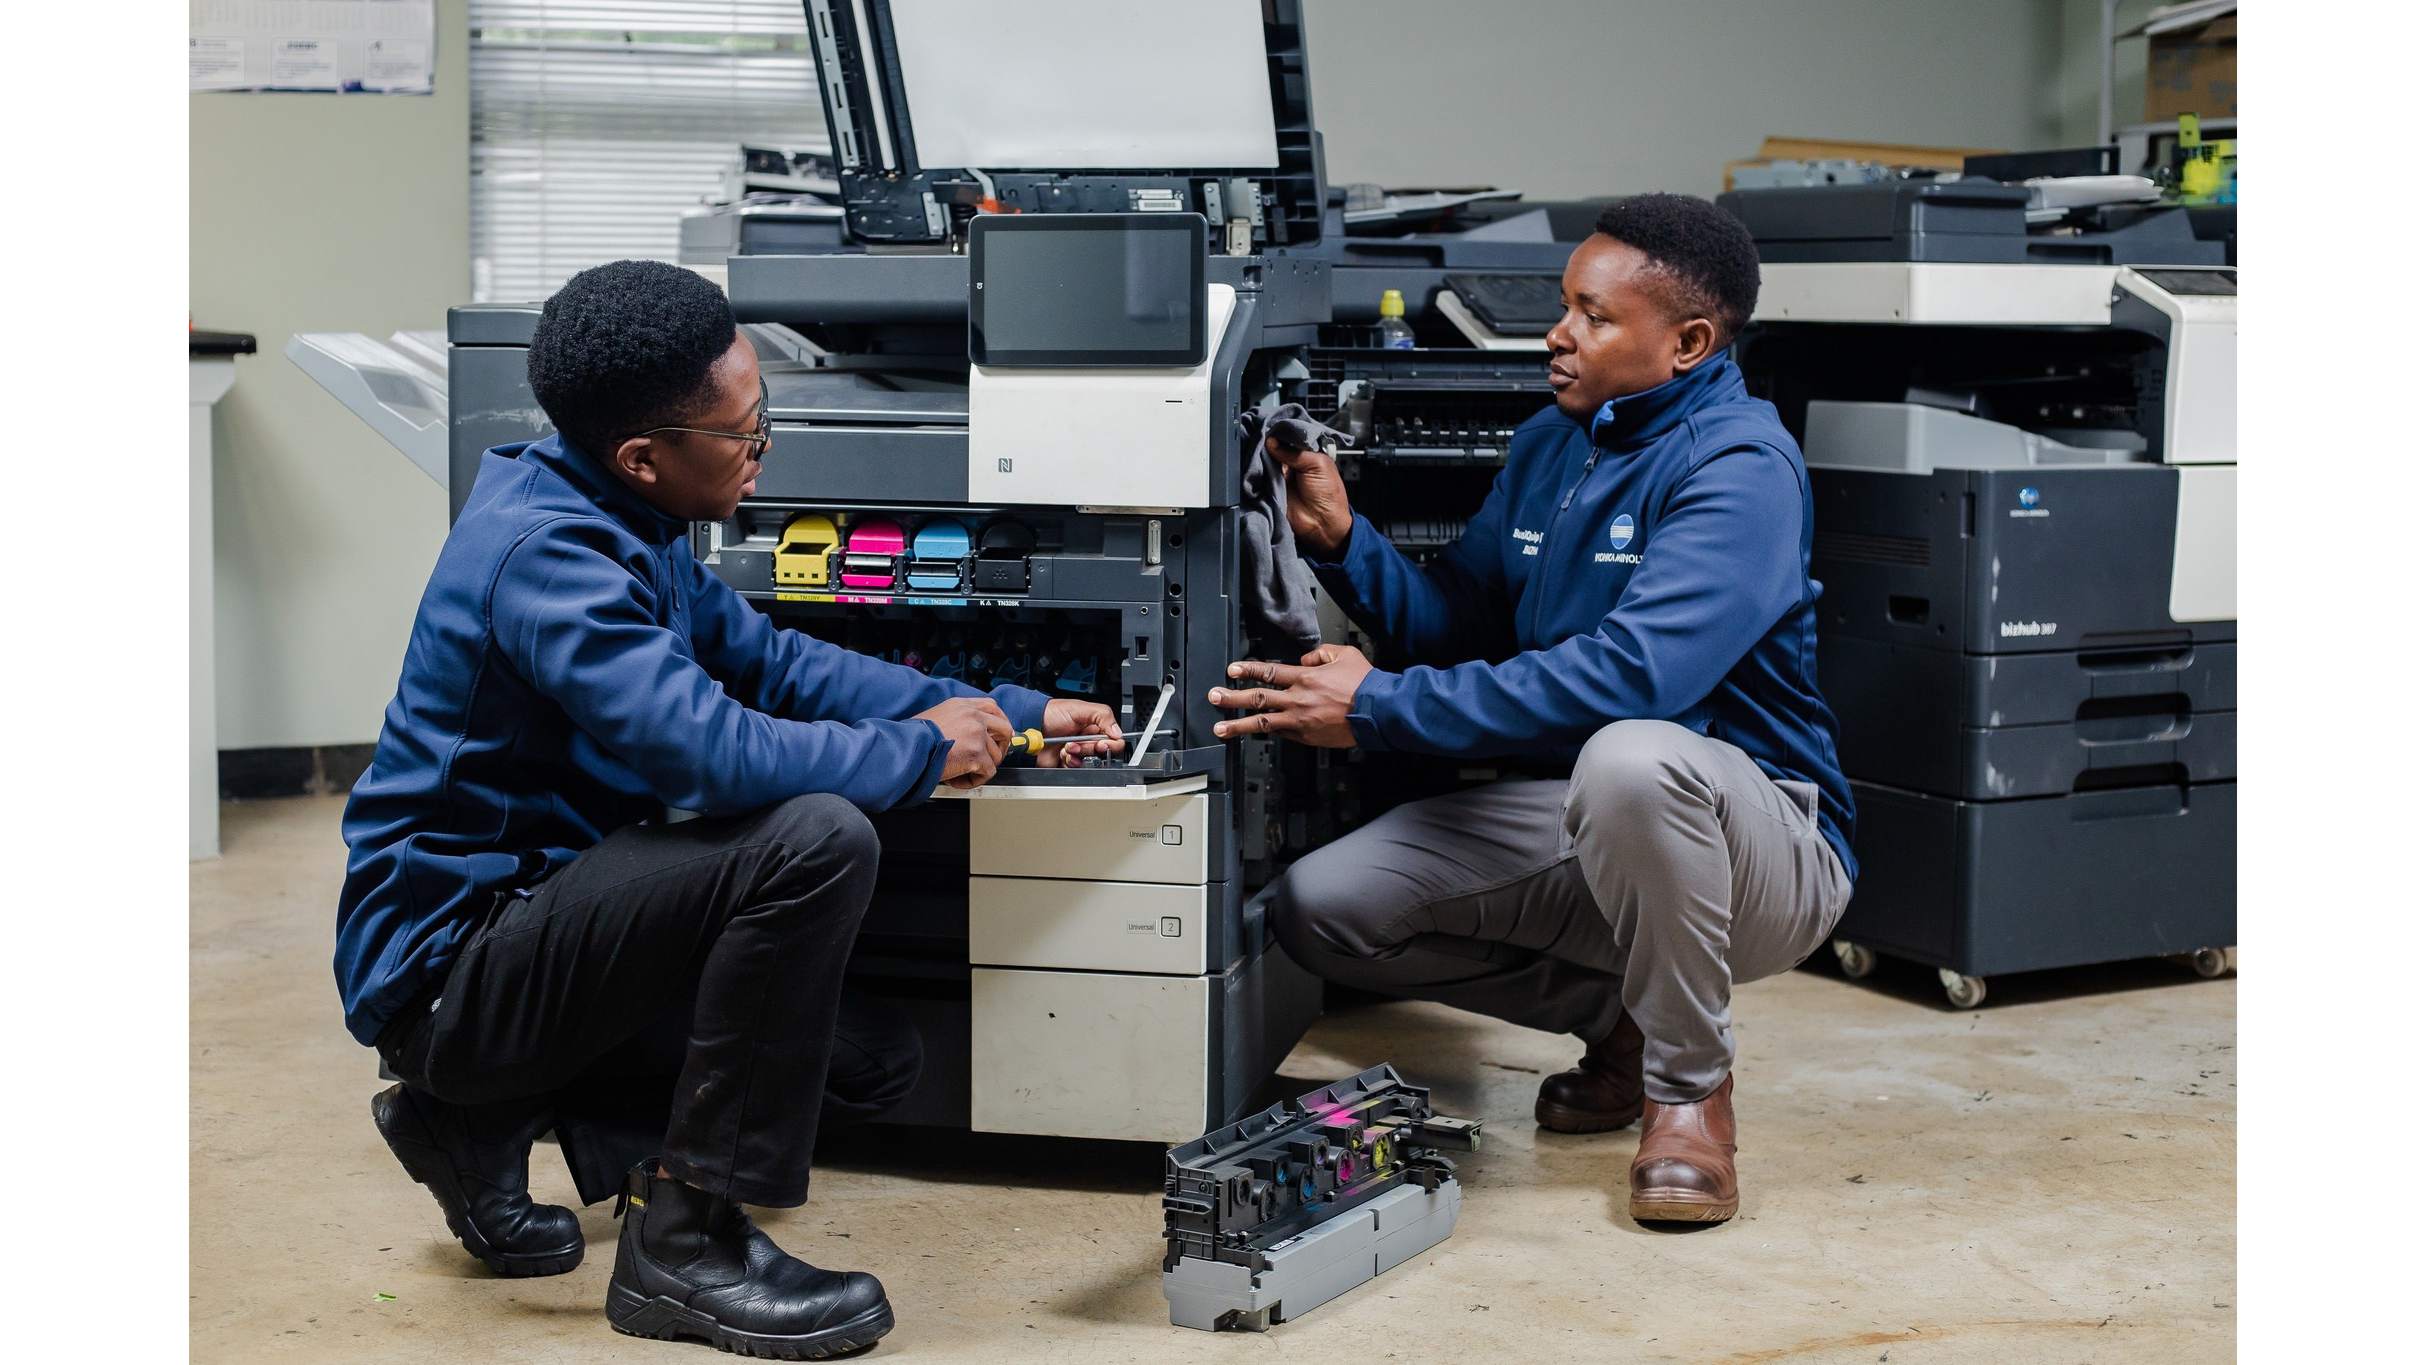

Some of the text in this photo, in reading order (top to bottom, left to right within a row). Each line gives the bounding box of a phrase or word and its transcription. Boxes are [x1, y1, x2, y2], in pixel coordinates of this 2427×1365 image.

[1615, 553, 1644, 565] MINOLT
[2001, 620, 2040, 637] bizhub
[1129, 831, 1155, 839] Universal
[1128, 923, 1154, 931] Universal
